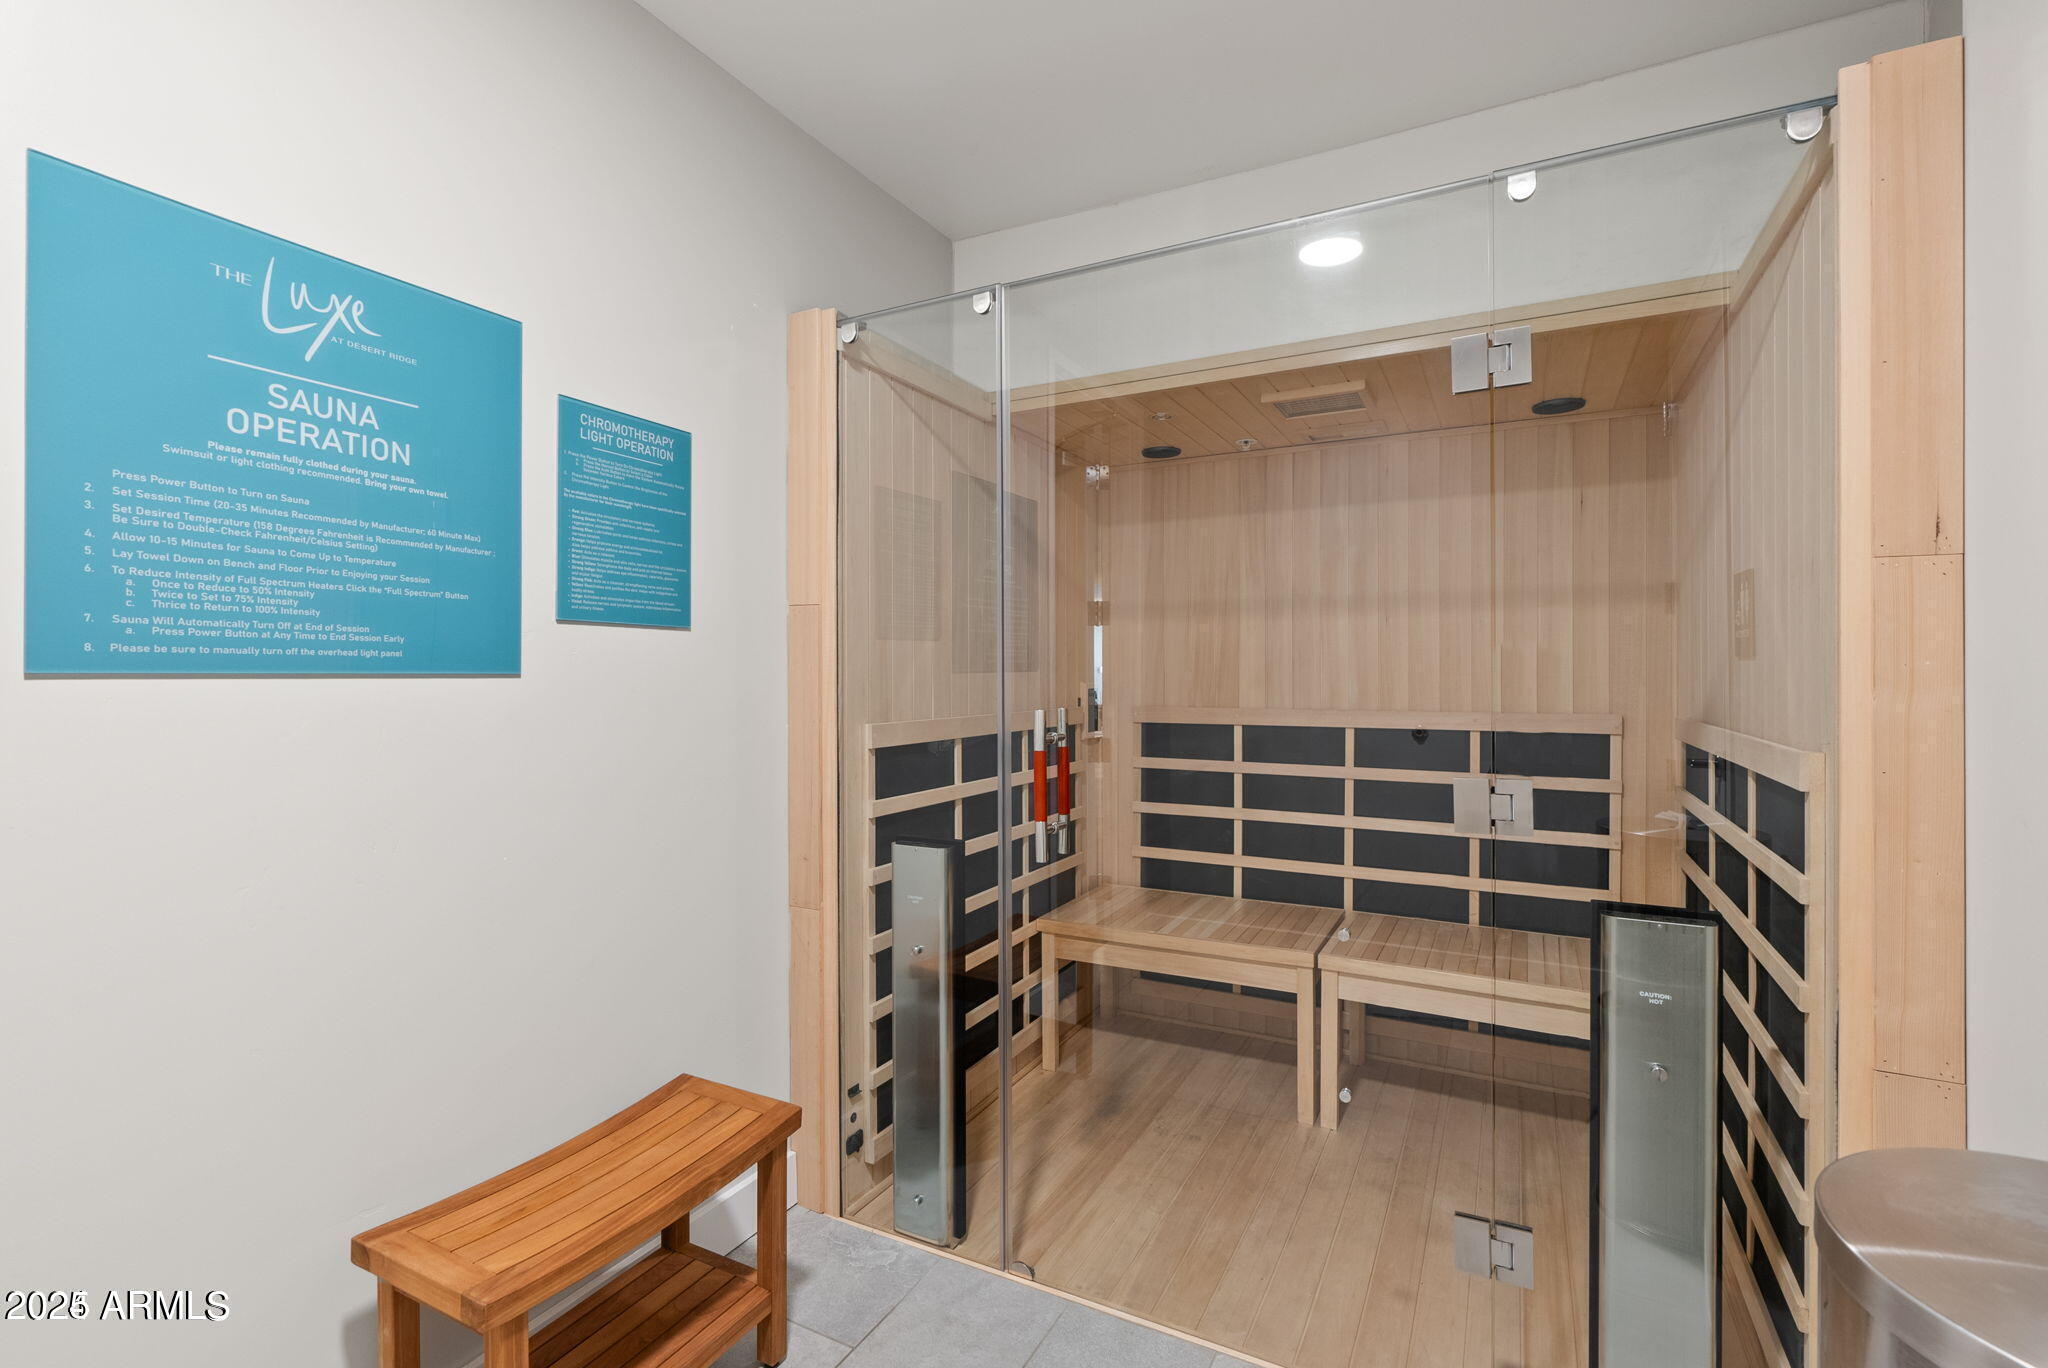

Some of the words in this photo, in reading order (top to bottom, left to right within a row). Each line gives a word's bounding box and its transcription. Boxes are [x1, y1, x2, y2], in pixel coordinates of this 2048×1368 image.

[209, 262, 253, 287] THE
[262, 256, 382, 362] Luxe
[330, 336, 343, 344] AT
[346, 340, 386, 356] DESERT
[388, 351, 417, 366] RIDGE
[267, 383, 379, 430] SAUNA
[226, 407, 410, 466] OPERATION
[580, 413, 674, 448] CHROMOTHERAPY
[580, 428, 613, 446] LIGHT
[616, 437, 674, 462] OPERATION
[162, 443, 213, 460] Swimsuit
[216, 454, 228, 462] or
[230, 455, 253, 467] light
[255, 460, 295, 475] clothing
[296, 468, 362, 484] recommended.
[364, 477, 387, 490] Bring
[388, 483, 407, 492] your
[207, 440, 243, 454] Please
[245, 448, 281, 461] remain
[282, 454, 304, 466] fully
[305, 459, 339, 471] clothed
[340, 464, 369, 478] during
[370, 471, 389, 479] your
[390, 474, 416, 485] sauna.
[111, 468, 147, 482] Press
[150, 474, 186, 487] Power
[189, 479, 225, 493] Button
[227, 486, 238, 495] to
[240, 487, 263, 499] Turn
[280, 493, 310, 506] Sauna
[84, 481, 94, 492] 2.
[112, 486, 132, 497] Set
[135, 489, 181, 503] Session
[183, 495, 210, 507] Time
[213, 498, 247, 512] (20-35
[250, 505, 289, 517] Minutes
[291, 509, 358, 527] Recommended
[359, 519, 369, 529] by
[437, 529, 463, 540] Minute
[463, 533, 481, 543] Max)
[84, 499, 95, 509] 3.
[112, 503, 132, 514] Set
[135, 505, 180, 520] Desired
[182, 511, 250, 528] Temperature
[253, 520, 273, 531] (158
[275, 523, 314, 537] Degrees
[317, 527, 364, 541] Fahrenheit
[375, 535, 433, 550] Recommended
[444, 543, 492, 556] Manufacturer
[84, 528, 95, 538] 4.
[111, 531, 146, 543] Allow
[149, 534, 177, 546] 10-15
[180, 538, 224, 550] Minutes
[226, 542, 241, 552] for
[244, 544, 275, 556] Sauna
[277, 548, 287, 557] to
[289, 549, 316, 559] Come
[318, 552, 331, 562] Up
[332, 554, 342, 562] to
[343, 554, 397, 568] Temperature
[112, 513, 128, 524] Be
[131, 515, 160, 528] Sure
[162, 520, 174, 529] to
[177, 521, 252, 537] Double-Check
[345, 540, 378, 553] Setting)
[83, 563, 95, 573] 6.
[111, 564, 126, 575] To
[128, 566, 172, 578] Reduce
[175, 570, 222, 583] Intensity
[224, 574, 234, 583] of
[237, 575, 256, 584] Full
[259, 577, 306, 588] Spectrum
[308, 580, 344, 591] Heaters
[345, 583, 367, 593] Click
[368, 585, 382, 594] the
[444, 591, 469, 600] Button
[84, 545, 95, 555] 5.
[111, 547, 133, 561] Lay
[135, 550, 170, 561] Towel
[172, 553, 204, 564] Down
[207, 558, 220, 566] on
[223, 558, 255, 569] Bench
[257, 563, 276, 571] and
[278, 563, 303, 573] Floor
[306, 565, 328, 575] Prior
[331, 568, 340, 576] to
[342, 568, 378, 581] Enjoying
[378, 574, 398, 582] your
[399, 574, 430, 584] Session
[151, 578, 180, 589] Once
[183, 582, 194, 590] to
[197, 581, 236, 593] Reduce
[239, 585, 249, 594] to
[252, 585, 272, 595] 50%
[274, 587, 315, 599] Intensity
[151, 588, 183, 600] Twice
[186, 592, 198, 600] to
[200, 591, 218, 601] Set
[221, 594, 232, 602] to
[234, 594, 254, 603] 75%
[257, 595, 299, 607] Intensity
[83, 612, 94, 622] 7.
[111, 614, 149, 625] Sauna
[152, 615, 174, 625] Will
[176, 617, 250, 630] Automatically
[252, 620, 274, 629] Turn
[277, 621, 291, 630] Off
[305, 622, 323, 631] End
[324, 623, 334, 631] of
[335, 623, 370, 633] Session
[151, 599, 186, 610] Thrice
[189, 602, 200, 610] to
[203, 602, 239, 612] Return
[241, 605, 252, 613] to
[255, 605, 278, 614] 100%
[280, 606, 321, 618] Intensity
[83, 642, 94, 652] 8.
[109, 642, 151, 653] Please
[153, 644, 168, 653] be
[171, 646, 196, 654] sure
[199, 646, 210, 654] to
[212, 646, 260, 656] manually
[262, 647, 283, 655] turn
[285, 647, 299, 655] off
[300, 647, 315, 656] the
[317, 648, 358, 657] overhead
[360, 649, 379, 658] light
[380, 649, 403, 658] panel
[151, 626, 185, 636] Press
[187, 627, 222, 637] Power
[224, 628, 258, 638] Button
[273, 631, 291, 641] Any
[293, 631, 316, 640] Time
[329, 632, 347, 641] End
[348, 632, 382, 642] Session
[383, 634, 405, 644] Early
